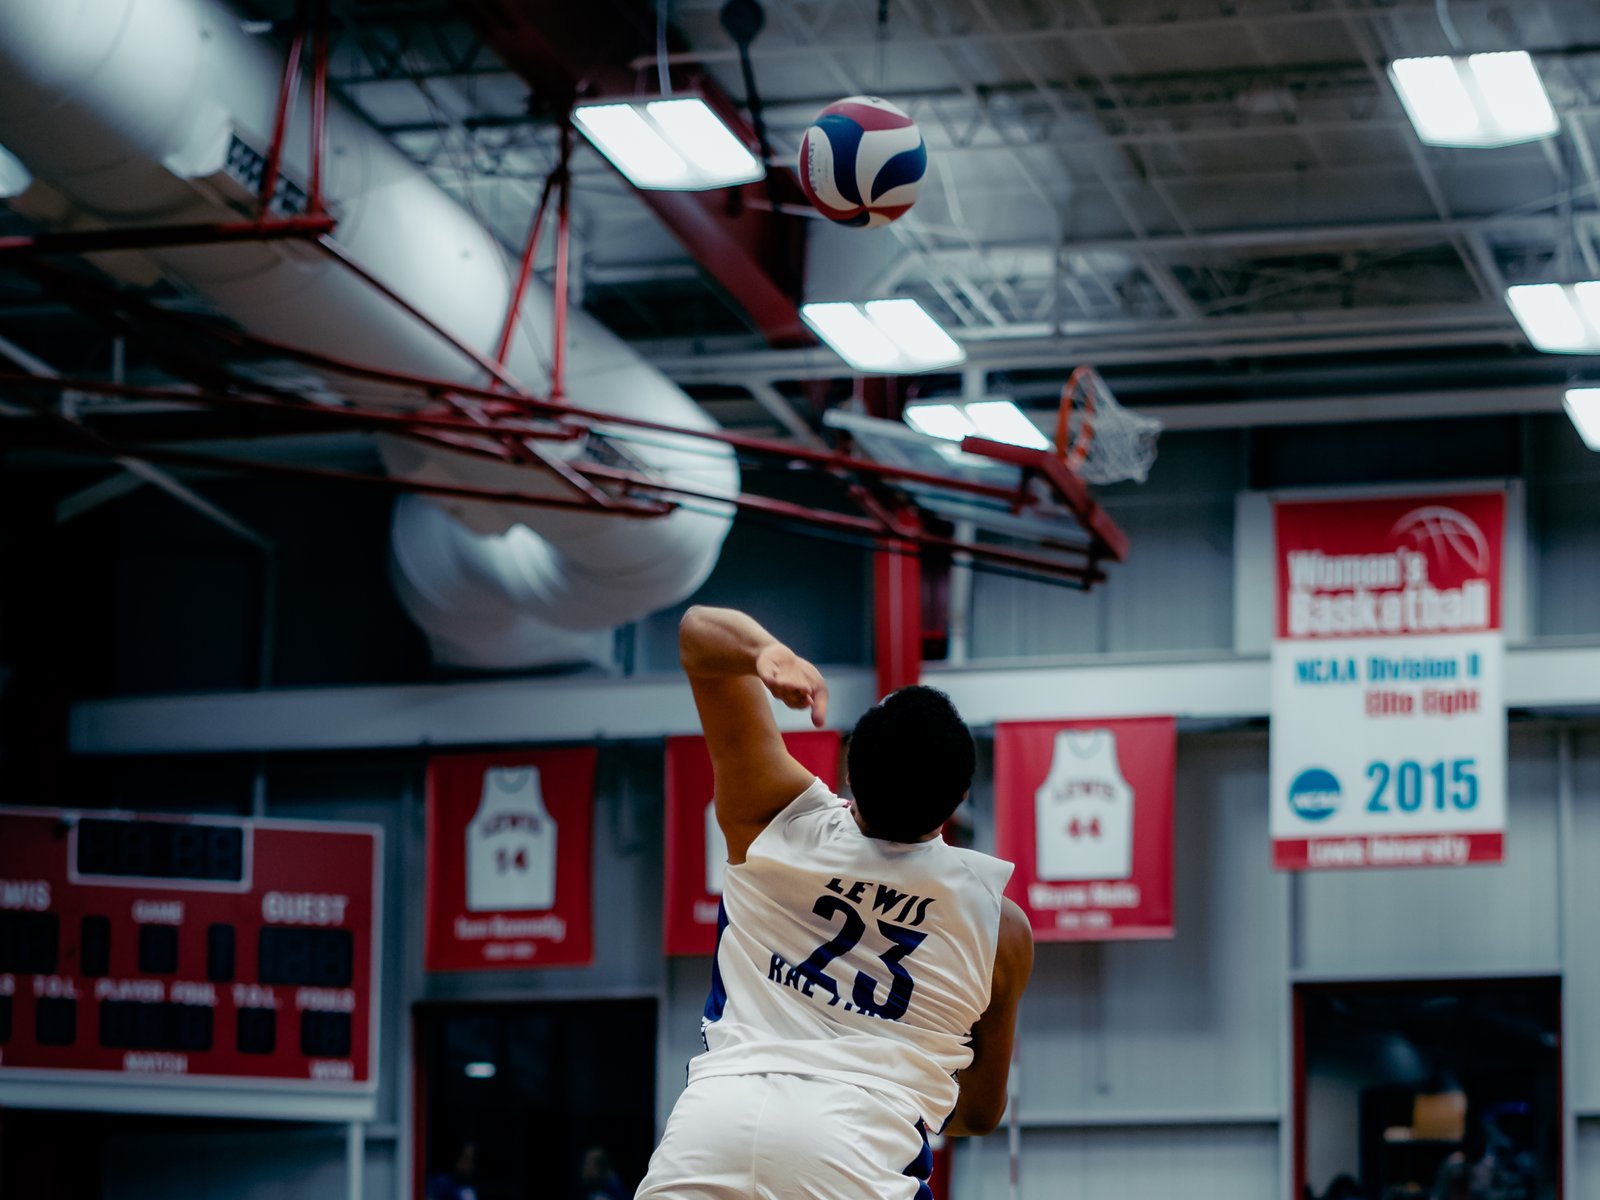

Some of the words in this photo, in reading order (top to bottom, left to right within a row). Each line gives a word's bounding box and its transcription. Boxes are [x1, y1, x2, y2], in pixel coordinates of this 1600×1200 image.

[1287, 547, 1427, 588] Women's
[1288, 578, 1490, 633] Basketball
[1296, 658, 1356, 682] NCAA
[1367, 655, 1458, 680] Division
[1365, 690, 1413, 715] Elite
[1422, 688, 1479, 717] Eight
[1366, 759, 1479, 813] 2015
[1066, 817, 1102, 843] 44
[495, 848, 528, 875] 14
[1367, 834, 1471, 865] University
[0, 880, 51, 911] WIS
[263, 891, 347, 925] GUEST
[824, 878, 936, 927] LEWIS
[132, 900, 185, 925] GAME
[812, 894, 928, 1021] 23
[96, 977, 165, 1001] PLAYER
[296, 988, 355, 1013] FOULS
